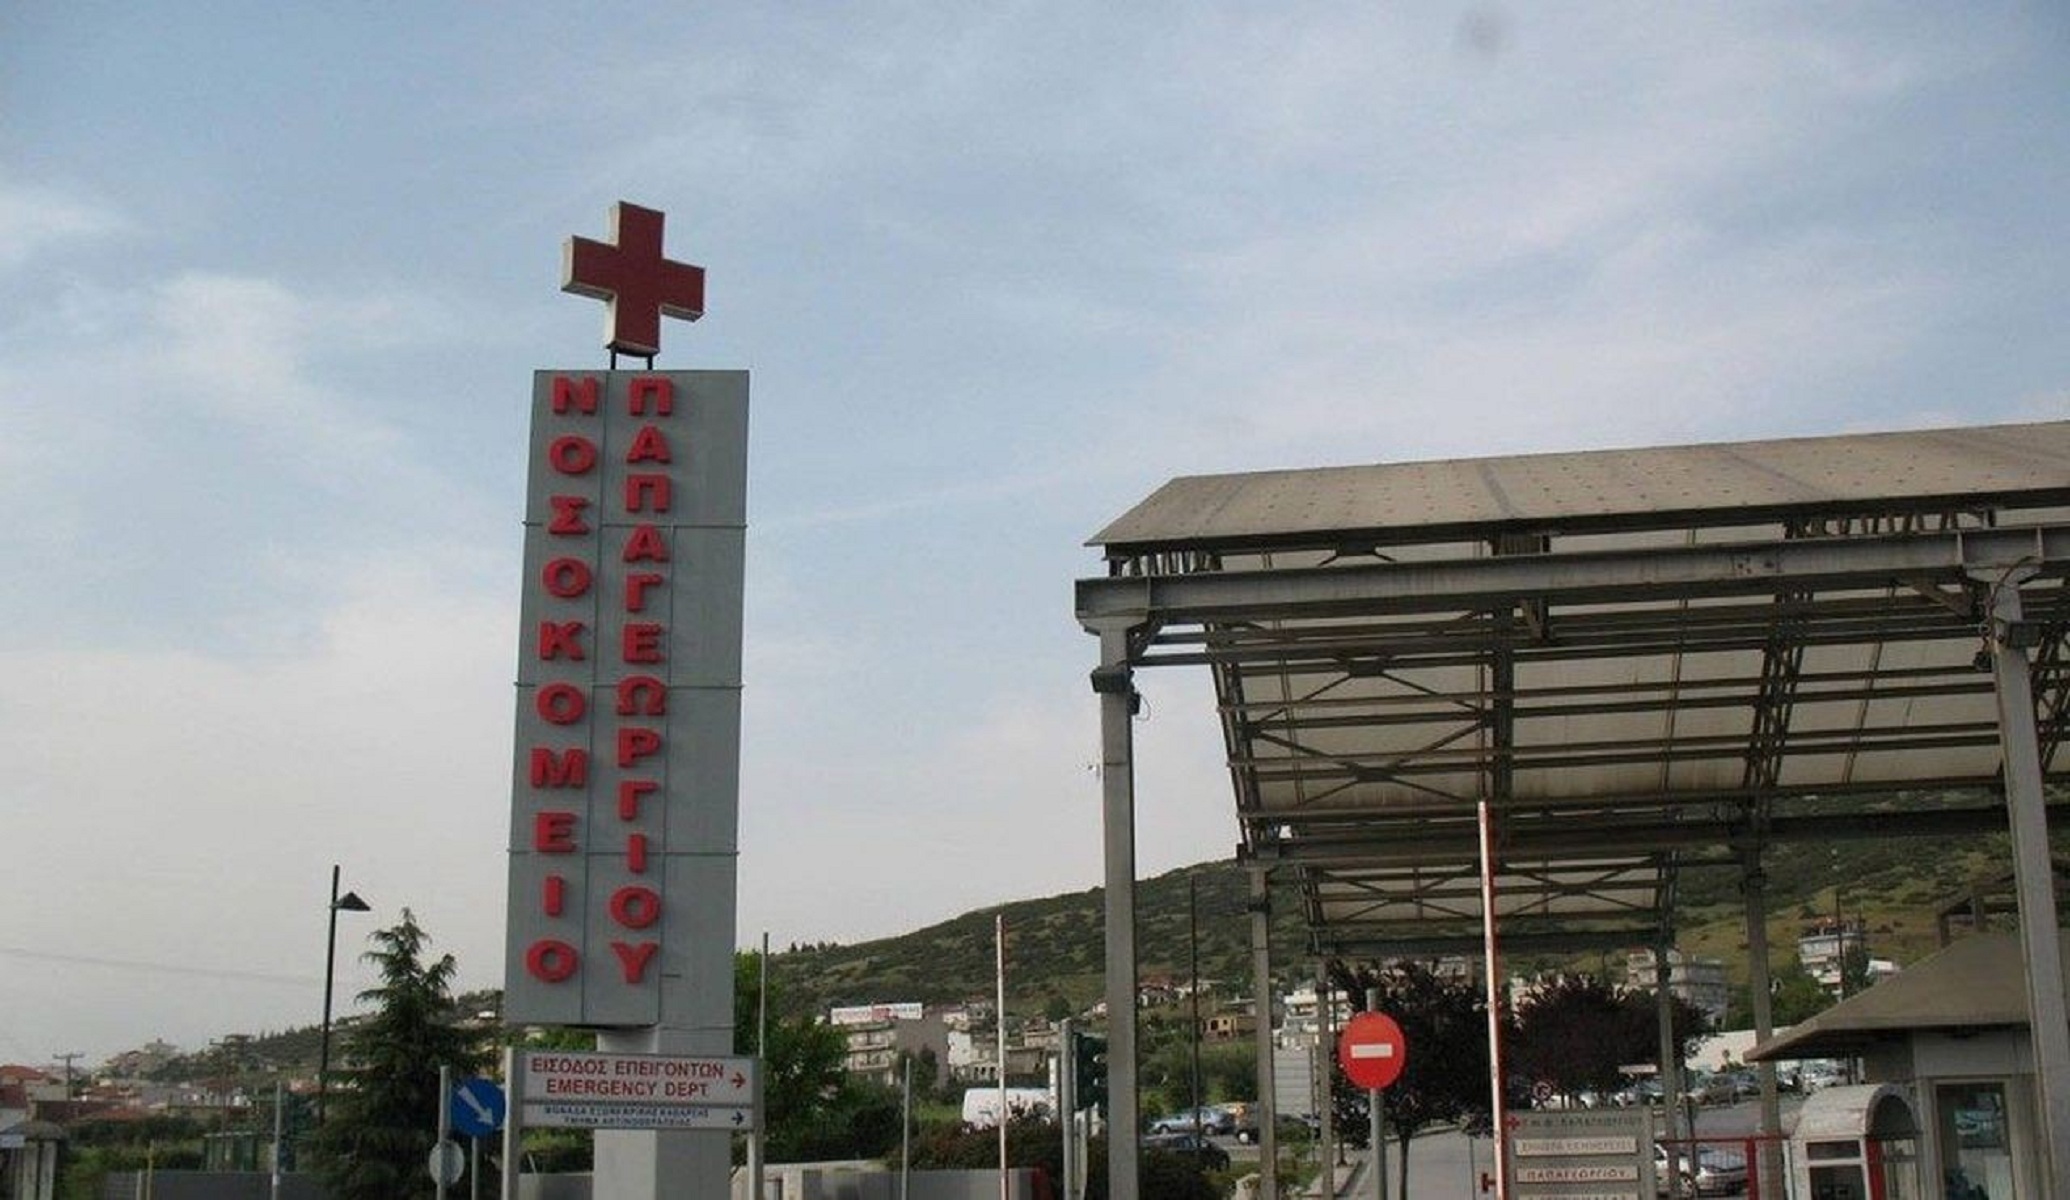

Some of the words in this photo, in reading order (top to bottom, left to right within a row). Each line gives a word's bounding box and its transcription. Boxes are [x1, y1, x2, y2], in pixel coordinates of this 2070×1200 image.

[525, 376, 600, 984] ΝΟΣΟΚΟΜΕΙΟ
[607, 377, 675, 985] ΠΑΠΑΓΕΩΡΓΙΟΥ
[531, 1057, 607, 1075] ΕΙΣΟΔΟΣ
[615, 1060, 724, 1079] ΕΠΕΙΓΟΝΤΩΝ
[546, 1078, 656, 1097] EMERGENCY
[664, 1081, 709, 1098] DEPT
